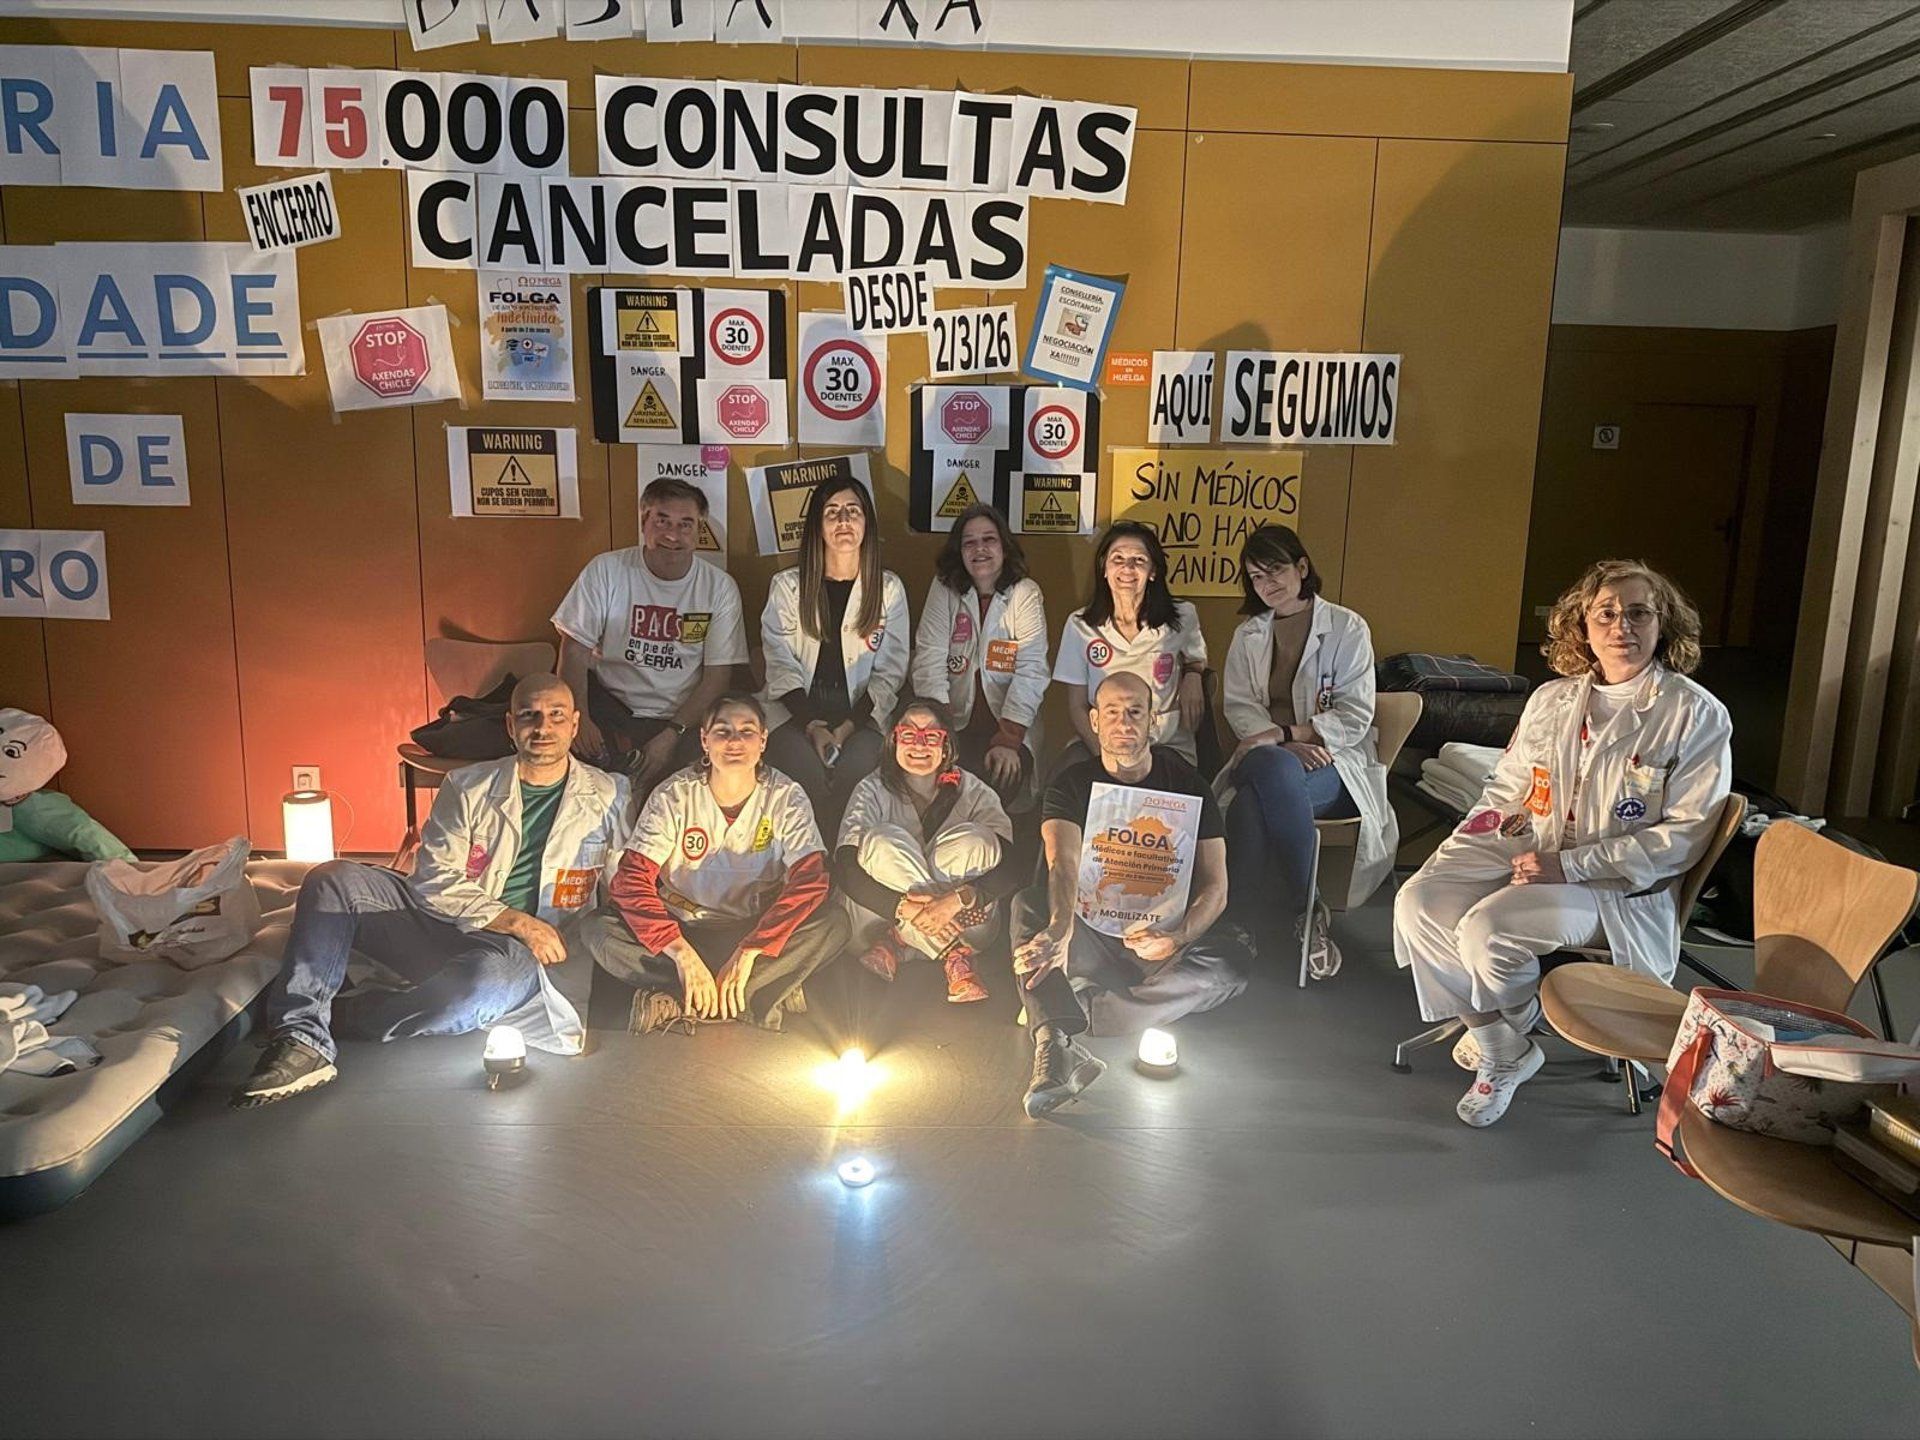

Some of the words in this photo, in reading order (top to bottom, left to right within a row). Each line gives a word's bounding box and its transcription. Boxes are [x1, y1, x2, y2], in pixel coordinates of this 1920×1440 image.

[1, 78, 210, 160] RIA
[268, 79, 565, 168] 75.000
[603, 85, 1132, 194] CONSULTAS
[246, 180, 333, 251] ENCIERRO
[417, 180, 1025, 281] CANCELADAS
[489, 291, 561, 304] FOLGA
[626, 295, 668, 307] WARNING
[848, 271, 928, 331] DESDE
[0, 274, 283, 350] DADE
[366, 330, 407, 348] STOP
[725, 327, 749, 344] 30
[933, 311, 1012, 372] 2/3/26
[722, 344, 751, 352] DOENTES
[831, 356, 854, 367] MAX
[372, 368, 416, 382] AXENDAS
[631, 366, 666, 377] DANGER
[826, 367, 859, 392] 30
[379, 379, 412, 390] CHICLE
[728, 394, 758, 404] STOP
[820, 392, 863, 402] DOENTES
[1153, 358, 1214, 437] AQUÍ
[1231, 358, 1396, 439] SEGUIMOS
[952, 401, 980, 410] STOP
[1043, 424, 1066, 440] 30
[482, 433, 543, 451] WARNING
[80, 434, 176, 487] DE
[946, 459, 980, 469] DANGER
[657, 463, 708, 477] DANGER
[780, 463, 838, 486] WARNING
[1033, 477, 1073, 489] WARNING
[1161, 511, 1201, 544] NO
[1, 550, 99, 601] RO
[628, 639, 641, 649] en
[661, 643, 675, 655] de
[1092, 646, 1107, 659] 30
[686, 835, 705, 850] 30
[1107, 827, 1169, 851] FOLGA
[1134, 850, 1184, 865] facultativos
[1143, 863, 1180, 874] Primaria
